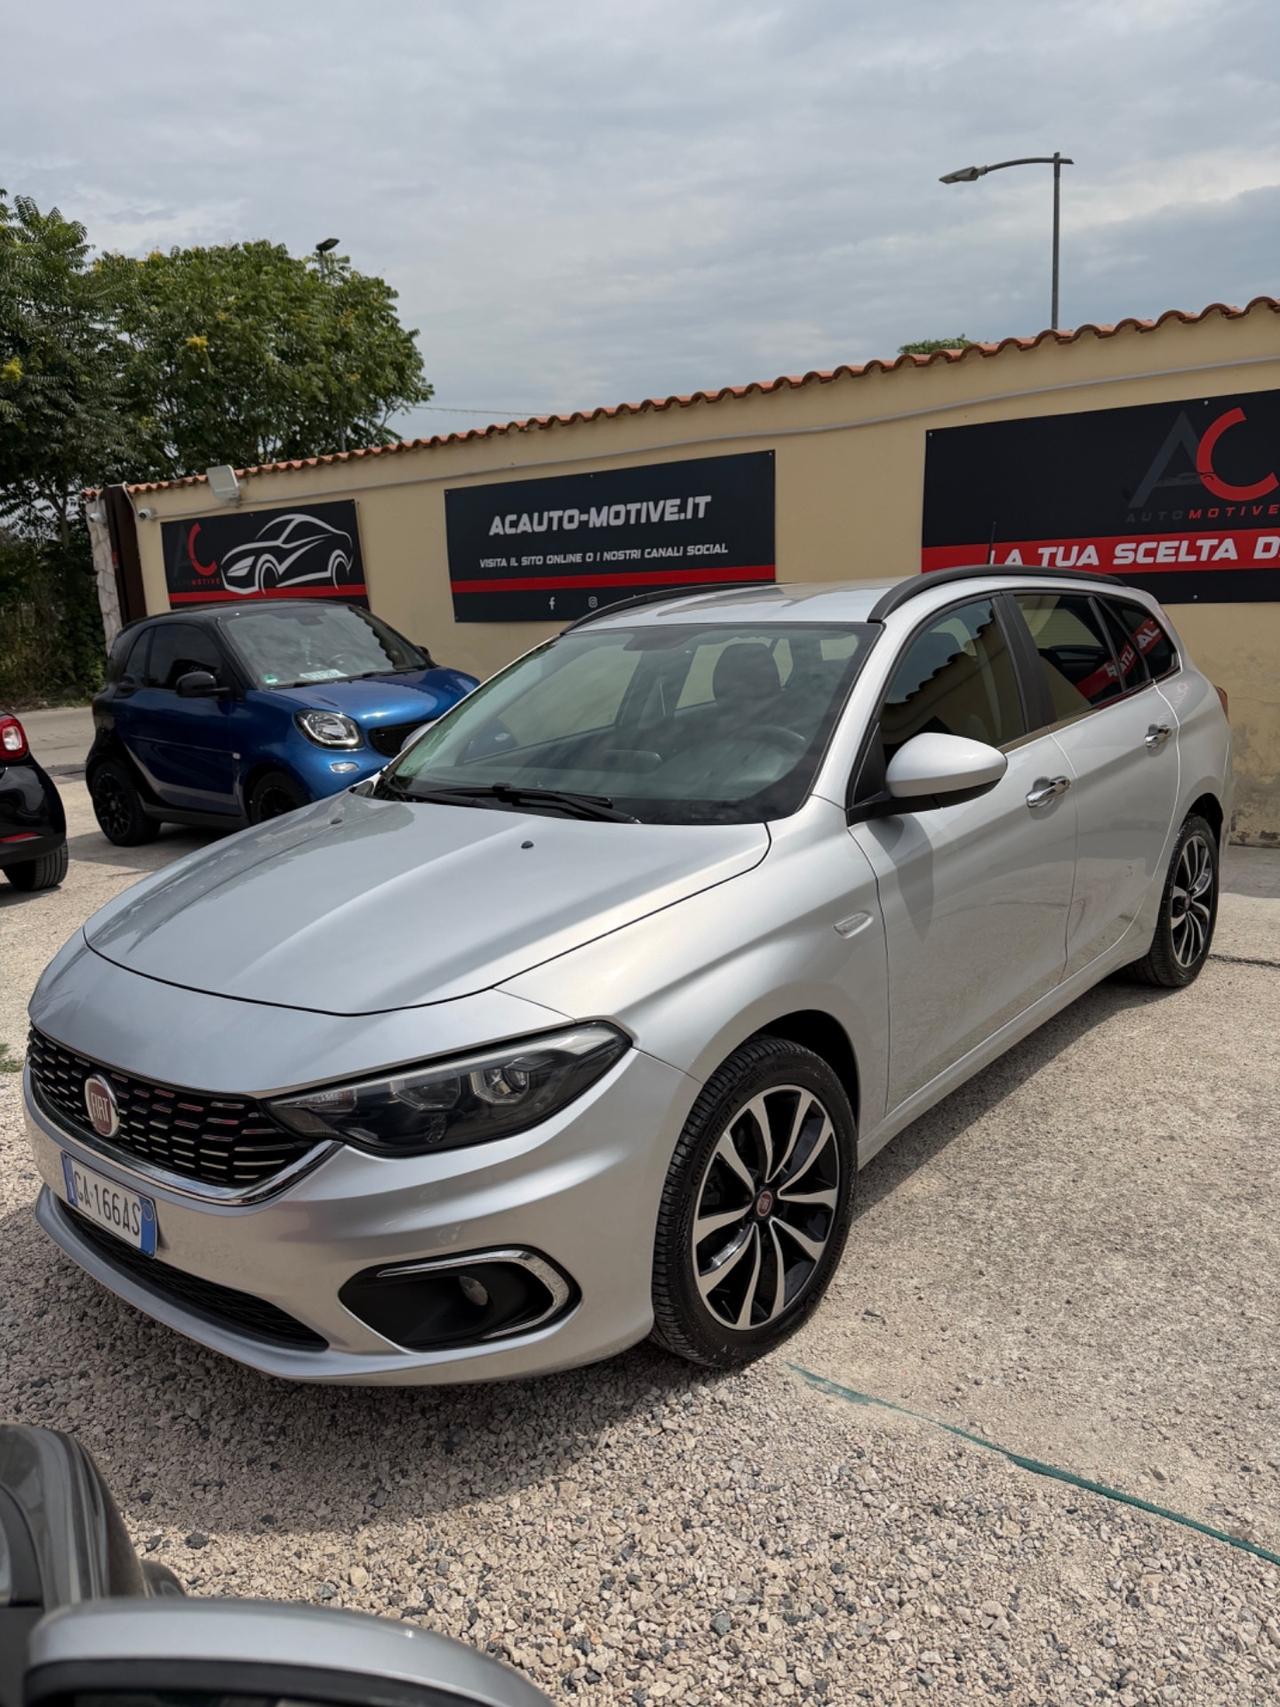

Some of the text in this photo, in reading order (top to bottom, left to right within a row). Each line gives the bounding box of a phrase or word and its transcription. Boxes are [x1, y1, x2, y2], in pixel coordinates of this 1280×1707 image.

[489, 495, 712, 536] ACAUTO-MOTIVE.IT
[480, 558, 508, 568] VISITA
[510, 557, 518, 566] IL
[521, 555, 544, 566] SITO
[546, 553, 583, 564] ONLINE
[603, 549, 641, 561] NOSTRI
[644, 546, 684, 558] CANALI
[687, 543, 728, 556] SOCIAL
[1038, 545, 1100, 568] TUA
[1112, 538, 1239, 565] SCELTA
